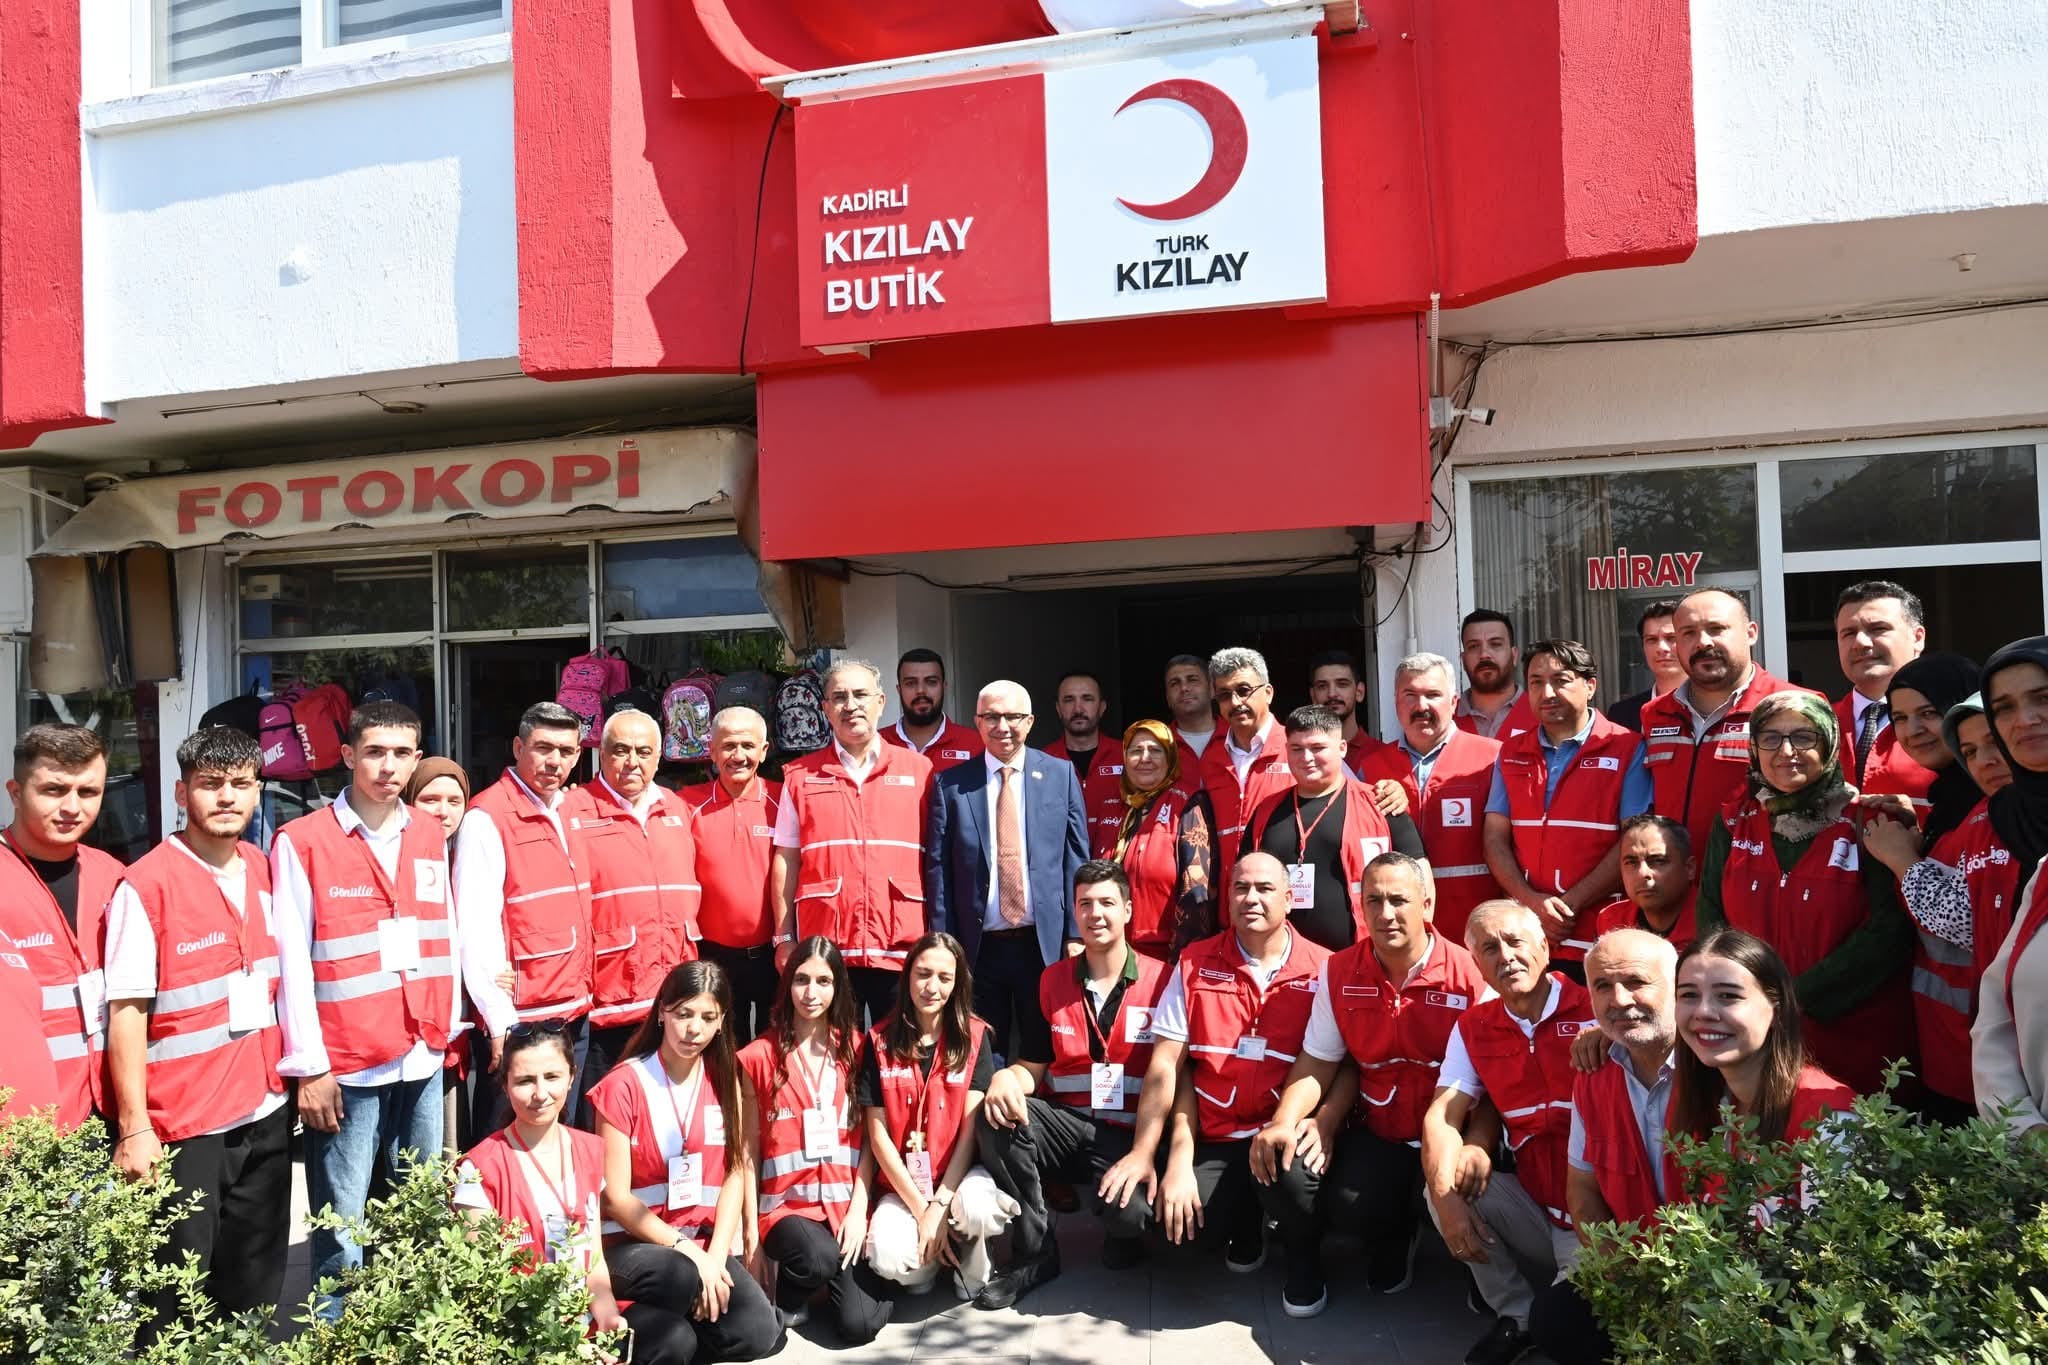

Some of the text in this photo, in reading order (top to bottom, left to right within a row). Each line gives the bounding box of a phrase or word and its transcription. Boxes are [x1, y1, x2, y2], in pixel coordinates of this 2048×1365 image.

[822, 184, 909, 215] KADİRLİ
[824, 216, 974, 265] KIZILAY
[1156, 233, 1210, 254] TÜRK
[826, 266, 946, 313] BUTİK
[1116, 251, 1250, 293] KIZILAY
[177, 439, 641, 535] FOTOKOPİ
[1587, 547, 1703, 590] MİRAY
[263, 741, 286, 767] NIKE
